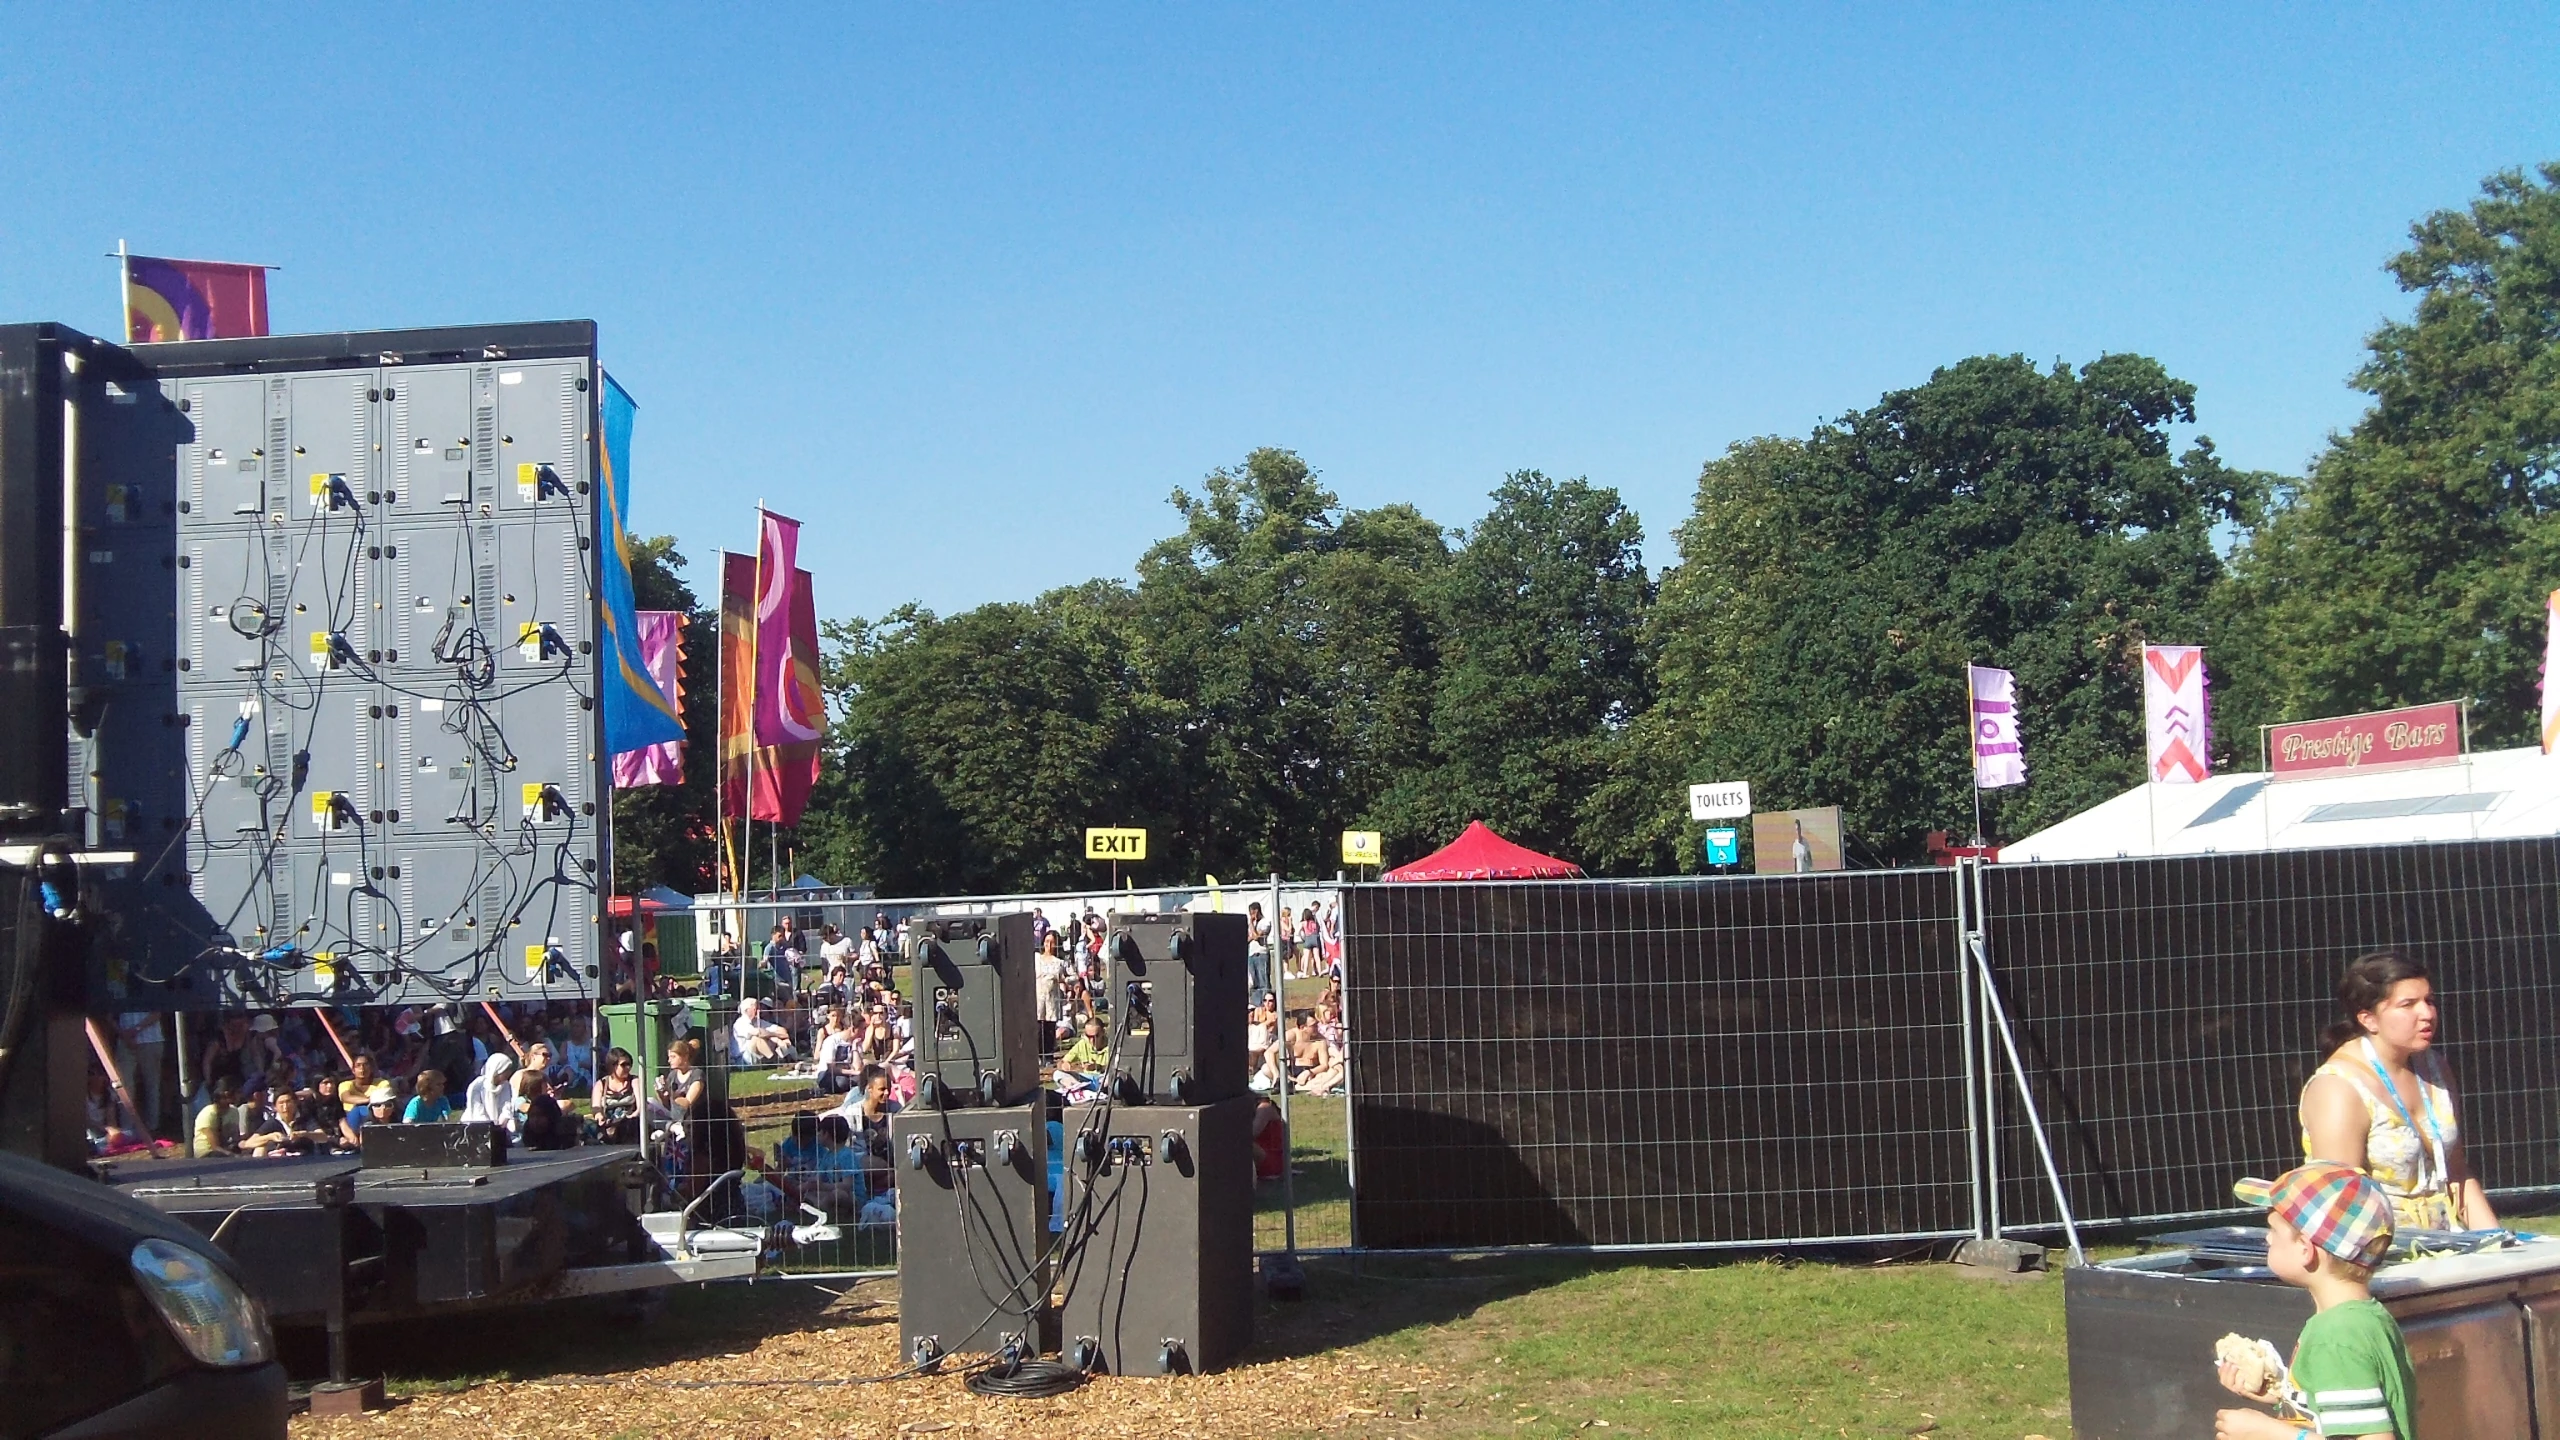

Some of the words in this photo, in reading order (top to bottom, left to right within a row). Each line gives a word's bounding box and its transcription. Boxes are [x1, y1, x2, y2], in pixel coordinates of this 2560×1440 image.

[2281, 726, 2374, 769] Prestige
[2385, 720, 2447, 751] Bars
[1697, 791, 1743, 808] TOILETS
[1092, 835, 1141, 853] EXIT
